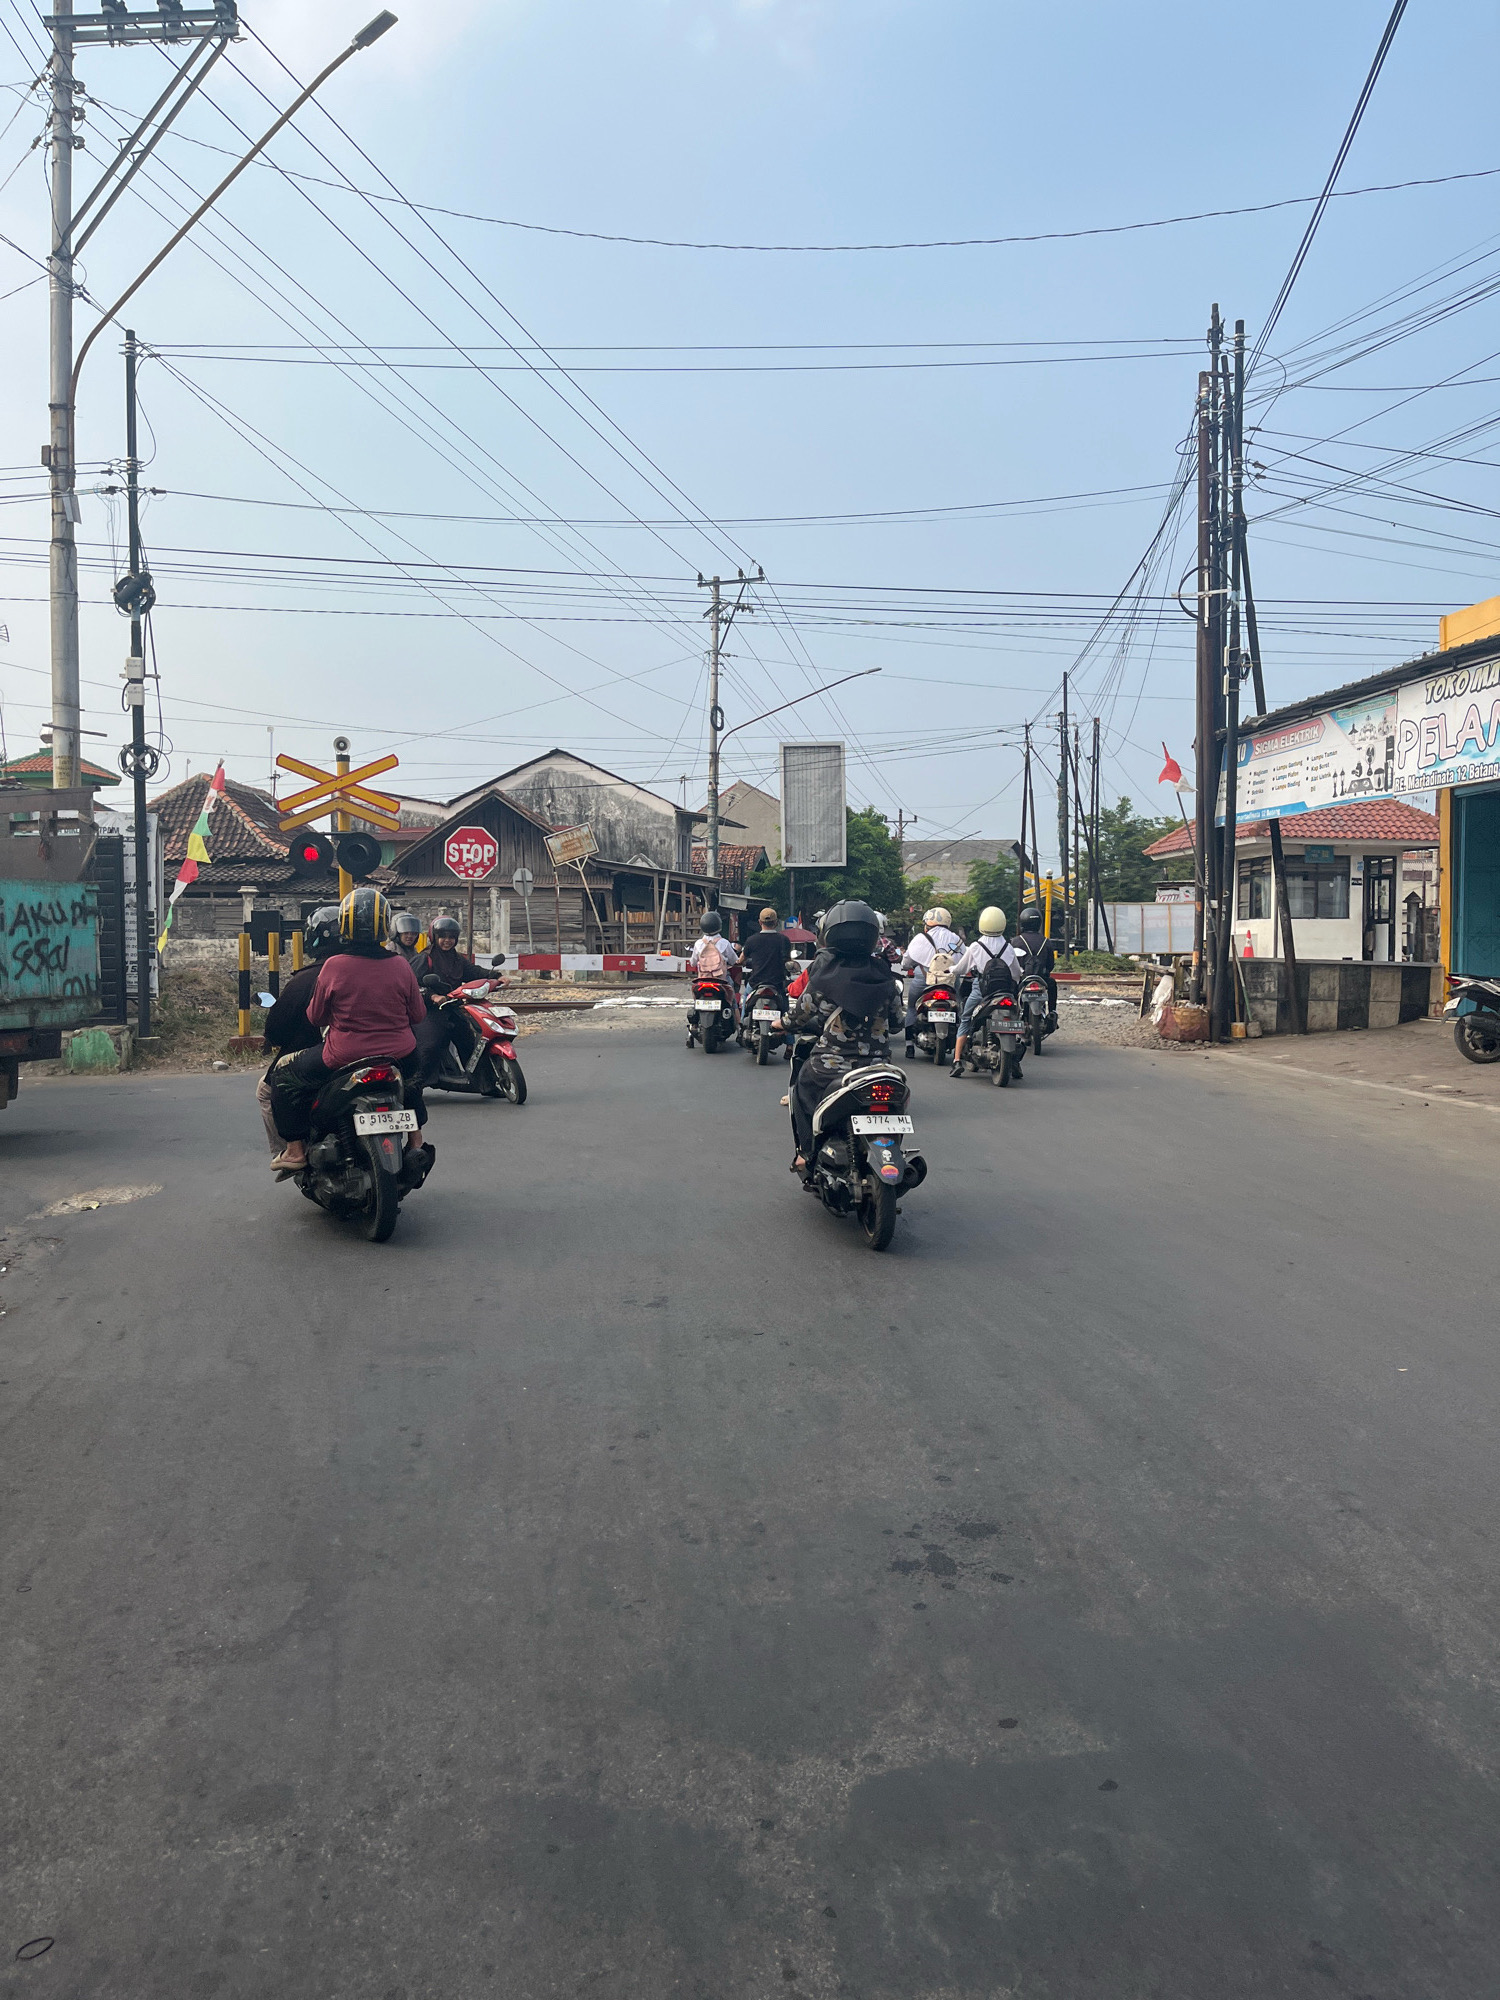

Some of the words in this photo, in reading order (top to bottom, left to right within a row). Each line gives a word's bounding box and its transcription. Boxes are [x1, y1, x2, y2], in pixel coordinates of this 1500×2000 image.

[1426, 670, 1470, 705] TOKO
[1254, 737, 1280, 756] SIGMA
[1280, 724, 1320, 749] ELEKTRIK
[1408, 767, 1455, 791] Martadinata
[1456, 765, 1467, 783] 12
[1468, 761, 1500, 781] Batang
[448, 842, 495, 864] STOP
[370, 1113, 394, 1125] 5135
[852, 1116, 859, 1125] G
[866, 1115, 890, 1125] 3774
[897, 1115, 911, 1125] ML
